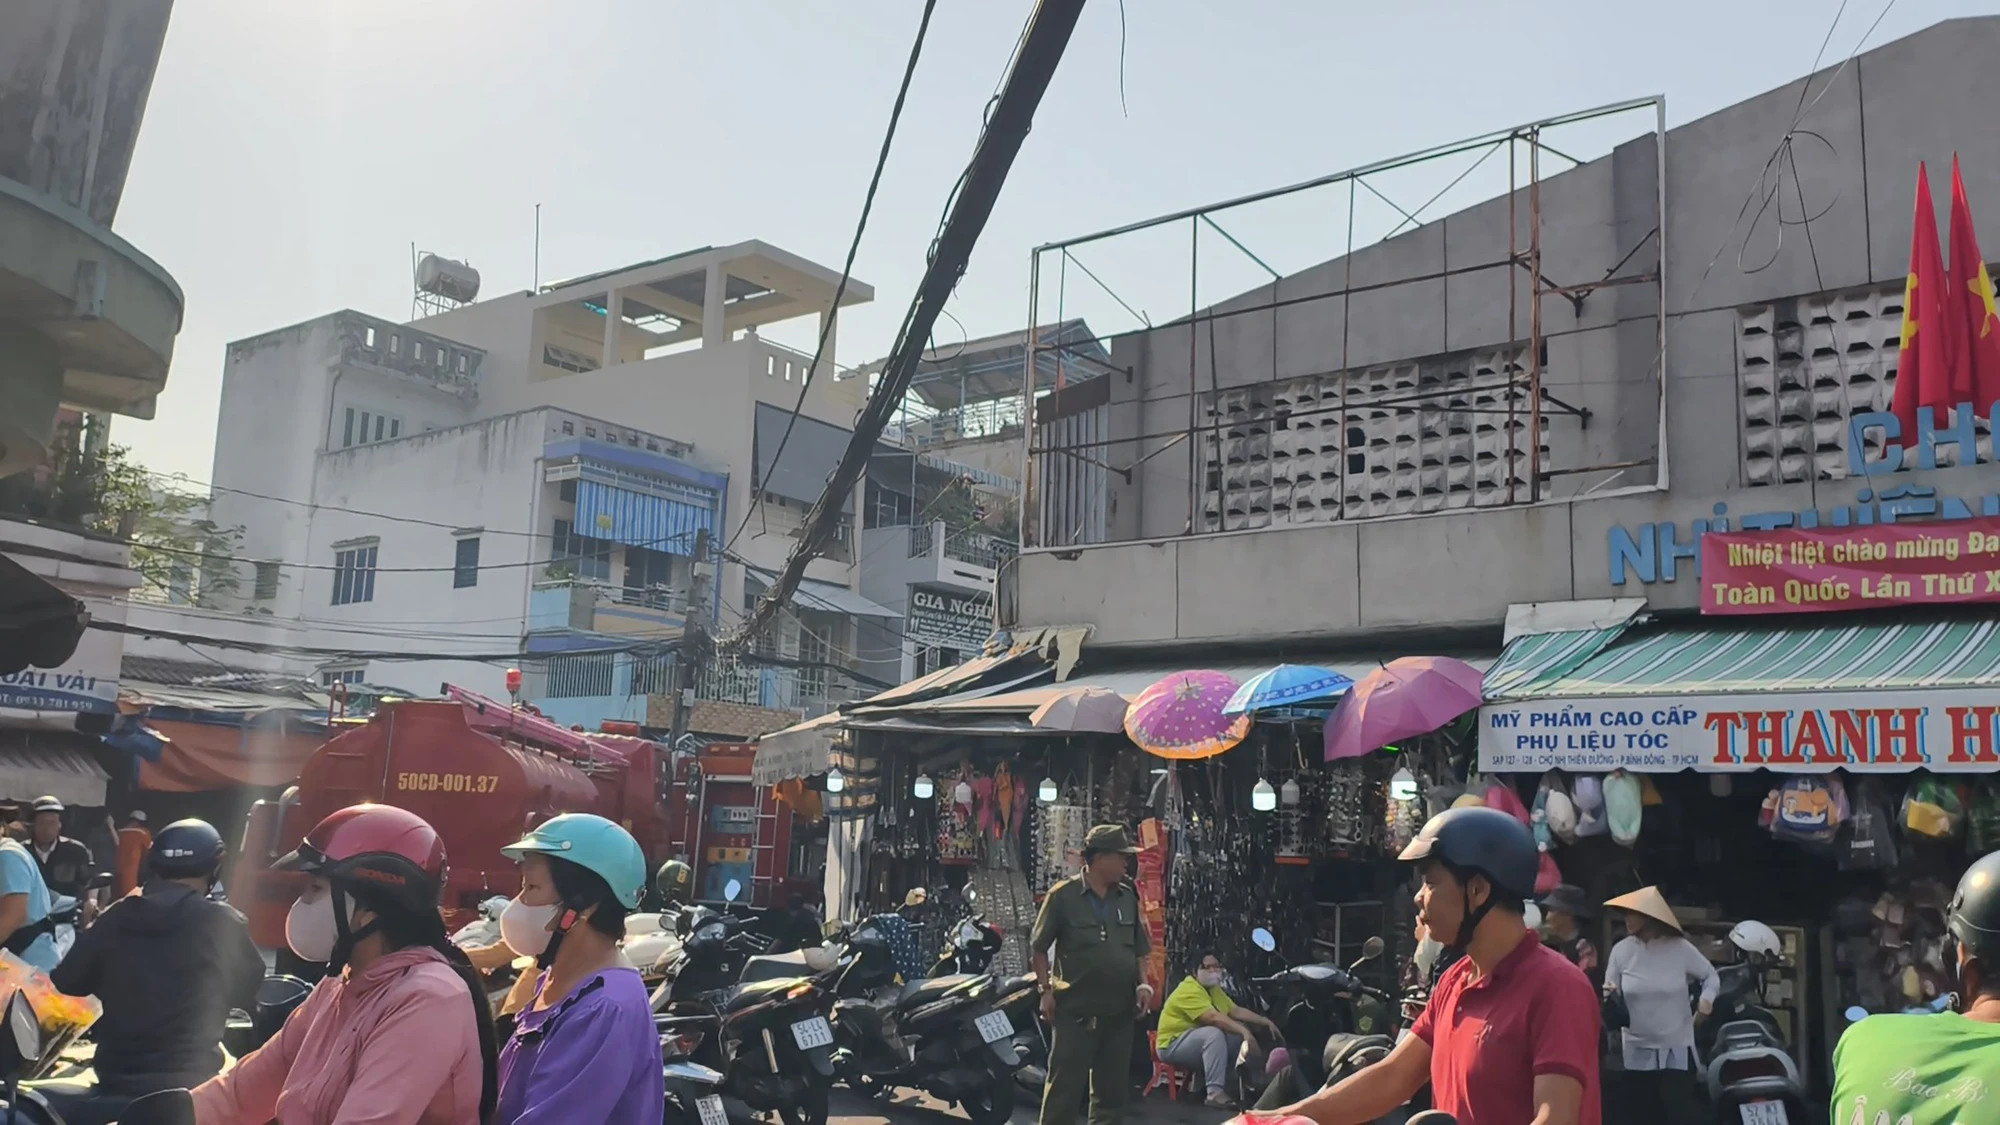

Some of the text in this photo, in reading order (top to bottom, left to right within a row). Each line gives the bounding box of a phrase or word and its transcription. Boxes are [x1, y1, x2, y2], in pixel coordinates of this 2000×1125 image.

[1848, 399, 2000, 476] CH
[1727, 542, 1783, 570] Nhiệt
[1790, 541, 1825, 569] liệt
[1833, 538, 1887, 563] chào
[1895, 533, 1959, 561] mừng
[1712, 581, 1775, 605] Toàn
[1784, 574, 1850, 605] Quốc
[1921, 570, 1977, 597] Thứ
[913, 591, 946, 612] GIA
[56, 668, 97, 692] VẢI
[1491, 703, 1698, 728] MỸ PHẨM CAO CẤP
[1516, 728, 1669, 752] PHỤ LIỆU TÓC
[1703, 706, 1932, 764] THANH
[397, 772, 499, 794] 50CD-001.37
